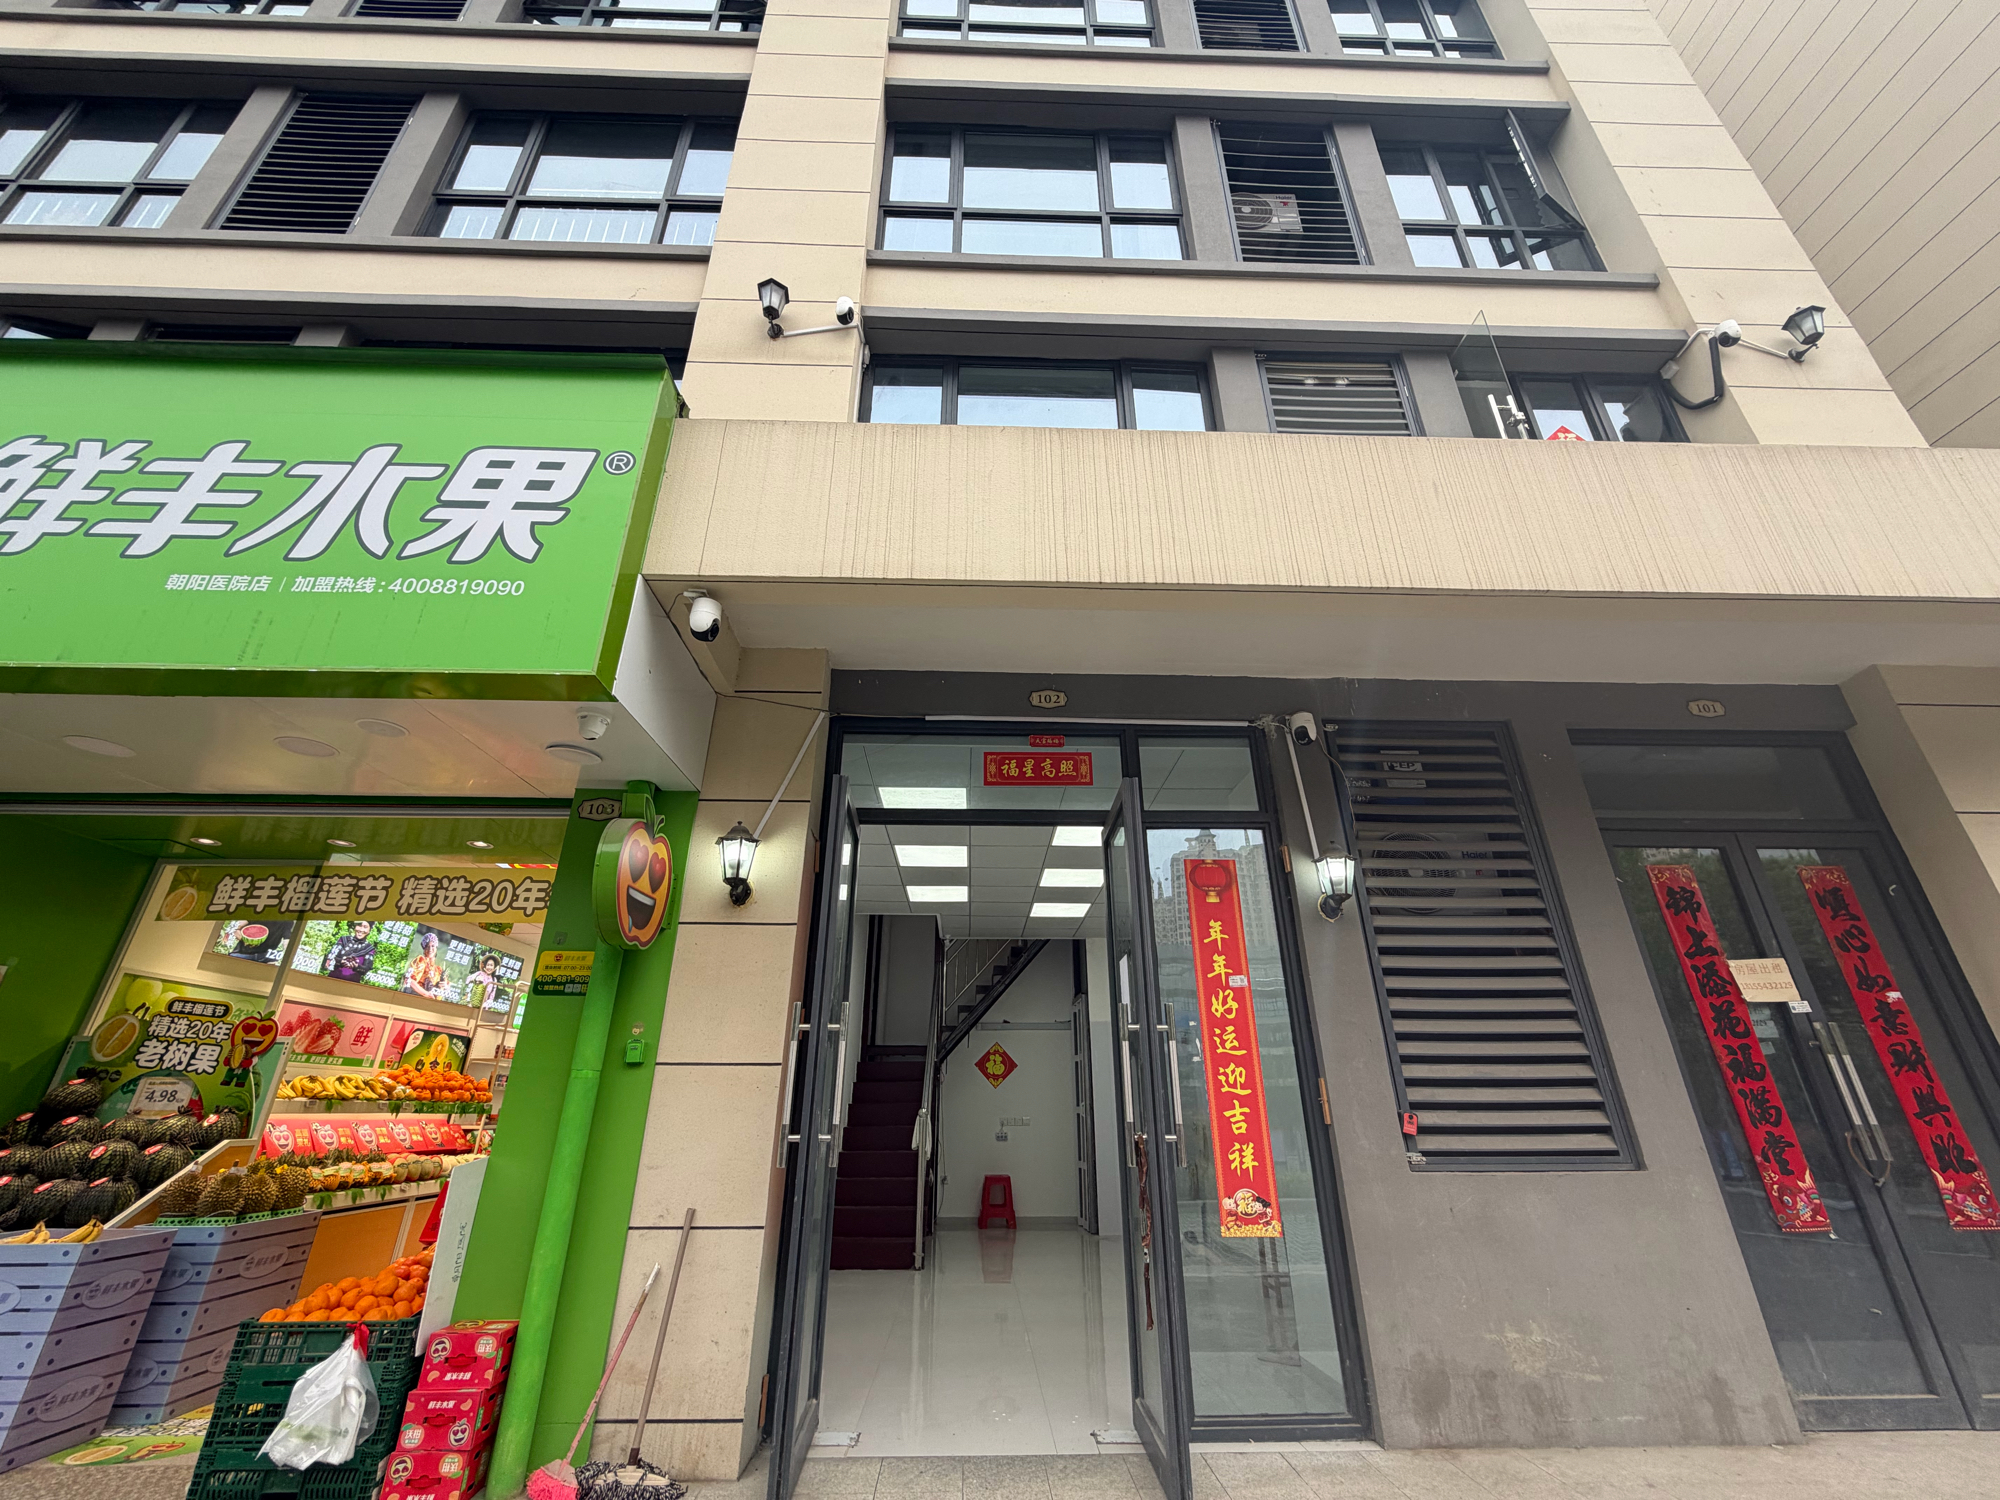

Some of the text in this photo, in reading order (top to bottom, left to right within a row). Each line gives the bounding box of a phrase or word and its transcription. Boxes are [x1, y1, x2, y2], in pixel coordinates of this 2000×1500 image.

[0, 436, 599, 564] 鲜丰水果
[165, 574, 272, 593] 朝阳医院店
[1037, 694, 1061, 704] 102
[1696, 703, 1718, 714] 101
[1001, 758, 1077, 778] 福星高照
[587, 803, 615, 815] 103
[1461, 851, 1488, 859] Haier
[208, 873, 553, 916] 鲜丰榴莲节 精选20年
[1734, 962, 1784, 975] 房屋出租
[537, 975, 590, 983] 400-881-909
[170, 1001, 227, 1017] 鲜丰榴莲节
[147, 1014, 233, 1043] 精选20年
[350, 1025, 374, 1047] 鲜
[134, 1037, 223, 1075] 老树果
[1203, 918, 1259, 1183] 年年好运迎吉祥
[985, 1053, 1006, 1076] 福
[145, 1089, 178, 1103] 4.98
[1237, 1192, 1256, 1214] 福
[404, 1429, 422, 1439] 沃柑
